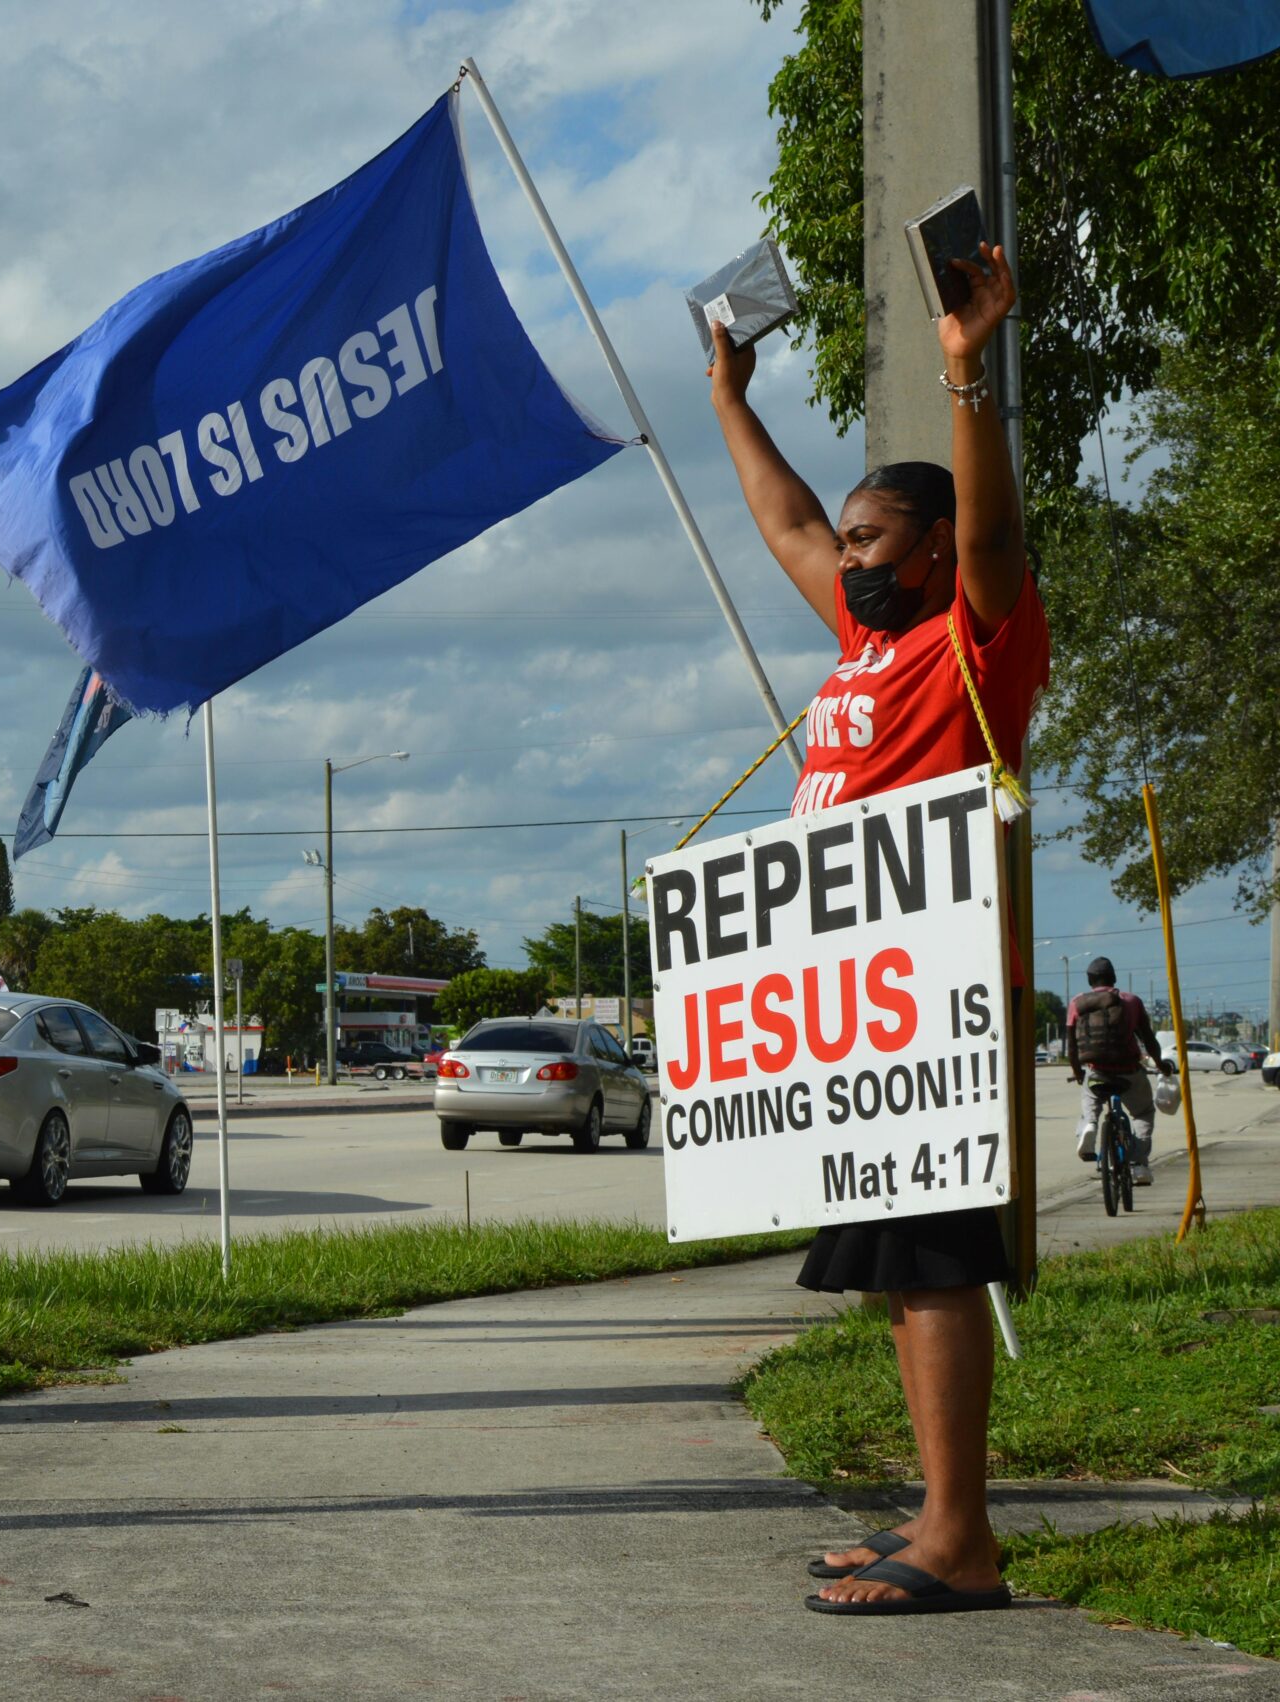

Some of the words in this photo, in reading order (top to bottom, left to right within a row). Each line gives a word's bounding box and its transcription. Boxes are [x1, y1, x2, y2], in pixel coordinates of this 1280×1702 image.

[259, 285, 443, 463] JESUS
[69, 430, 201, 549] LORD
[198, 400, 264, 497] IS
[807, 691, 875, 748] OVE'S
[651, 786, 988, 972] REPENT
[666, 946, 919, 1091] JESUS
[950, 983, 991, 1039] IS
[666, 1081, 813, 1151] COMING
[826, 1050, 999, 1125] SOON!!!
[823, 1152, 898, 1203] Mat
[911, 1133, 1000, 1191] 4:17
